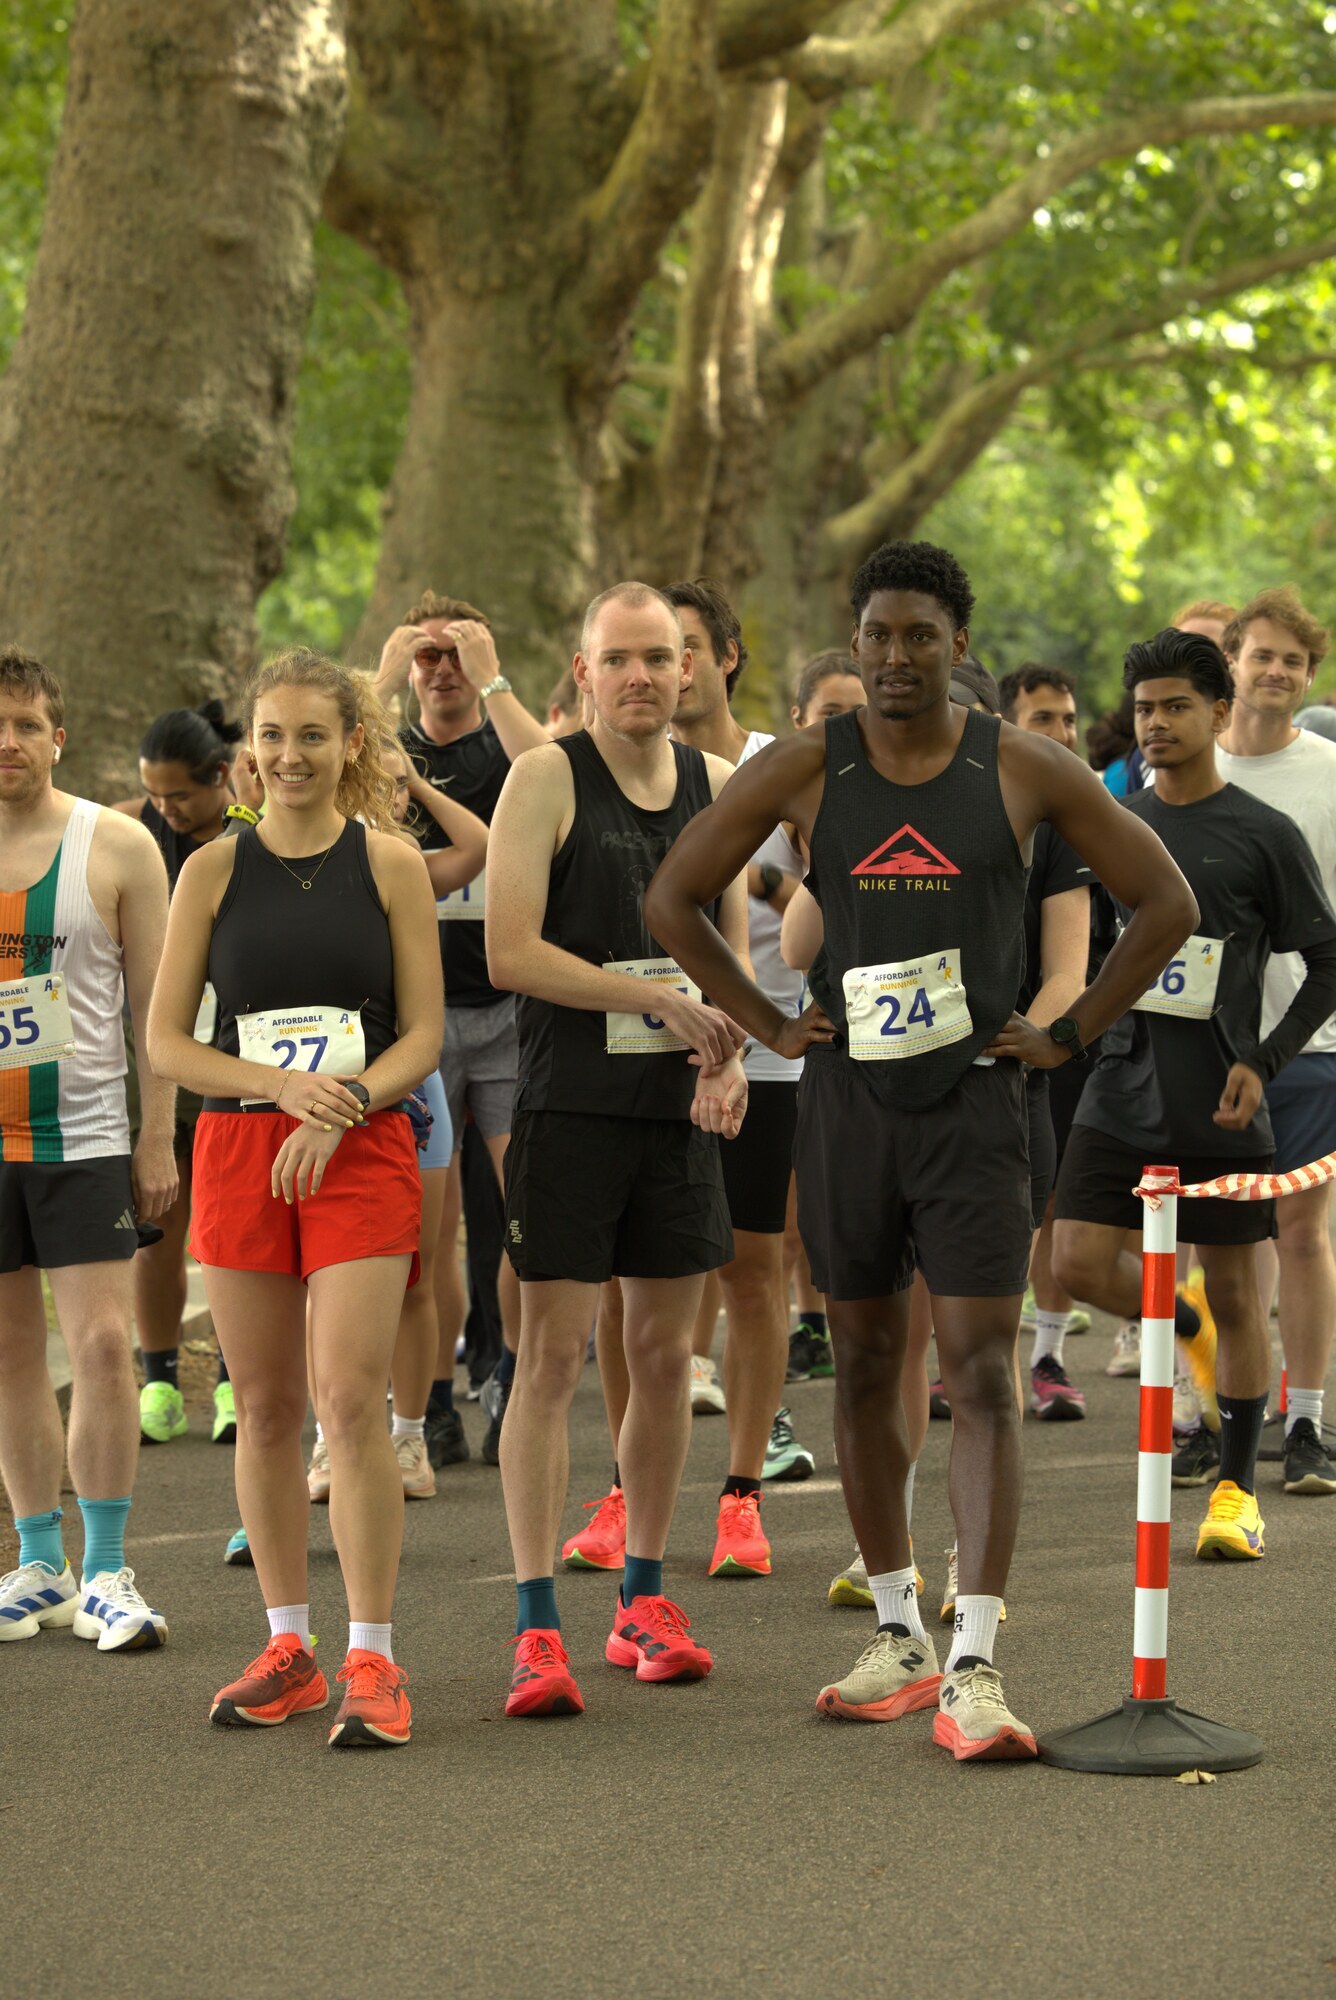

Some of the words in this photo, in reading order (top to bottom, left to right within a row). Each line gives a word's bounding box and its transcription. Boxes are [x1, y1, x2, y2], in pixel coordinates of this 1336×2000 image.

[859, 879, 897, 891] NIKE
[905, 879, 951, 891] TRAIL
[874, 967, 924, 981] AFFORDABLE
[879, 977, 919, 991] RUNNING
[875, 987, 937, 1037] 24
[272, 1015, 323, 1026] AFFORDABLE
[279, 1025, 318, 1035] RUNNING
[271, 1036, 328, 1072] 27
